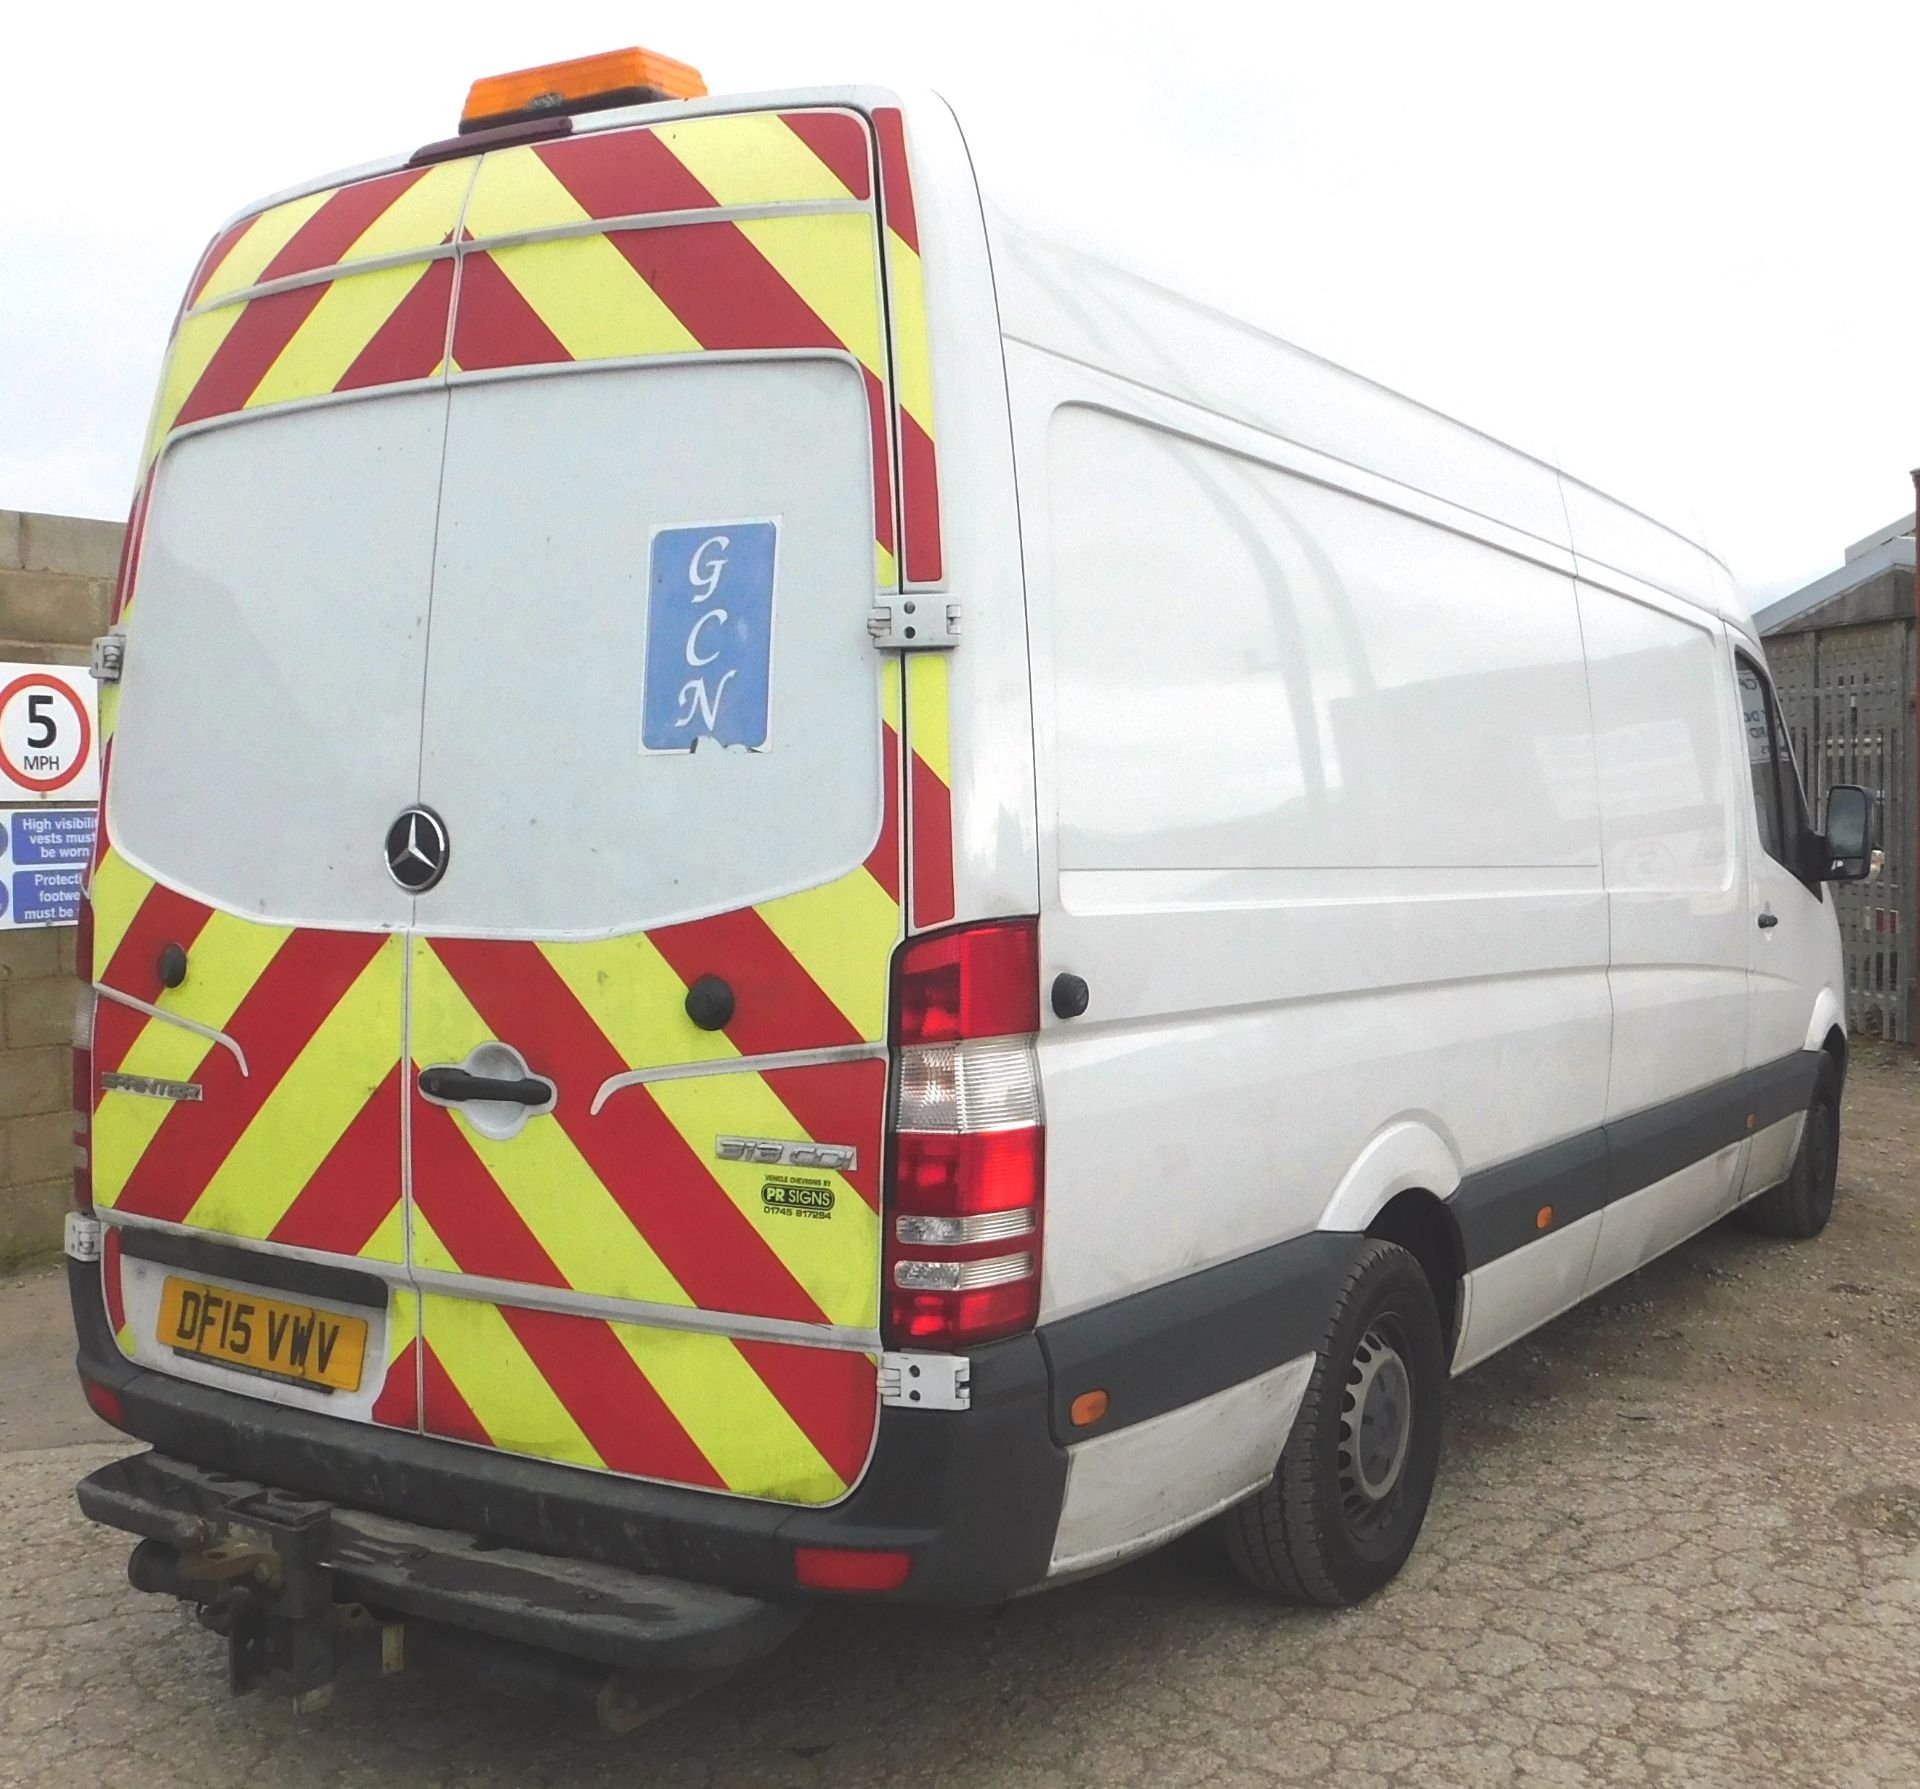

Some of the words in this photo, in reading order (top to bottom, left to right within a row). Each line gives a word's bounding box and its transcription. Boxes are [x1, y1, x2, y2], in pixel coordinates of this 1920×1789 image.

[27, 694, 57, 749] 5
[23, 756, 60, 772] MPH
[23, 818, 51, 833] High
[29, 833, 63, 844] vests
[66, 831, 96, 843] must
[41, 846, 56, 858] be
[59, 847, 90, 857] worn
[24, 907, 56, 919] must
[59, 905, 74, 918] be
[789, 1145, 856, 1169] CDI
[766, 1187, 786, 1202] PR
[788, 1189, 831, 1207] SIGNS
[764, 1206, 793, 1216] 01745
[176, 1289, 255, 1355] DF15
[268, 1309, 340, 1374] VWV
